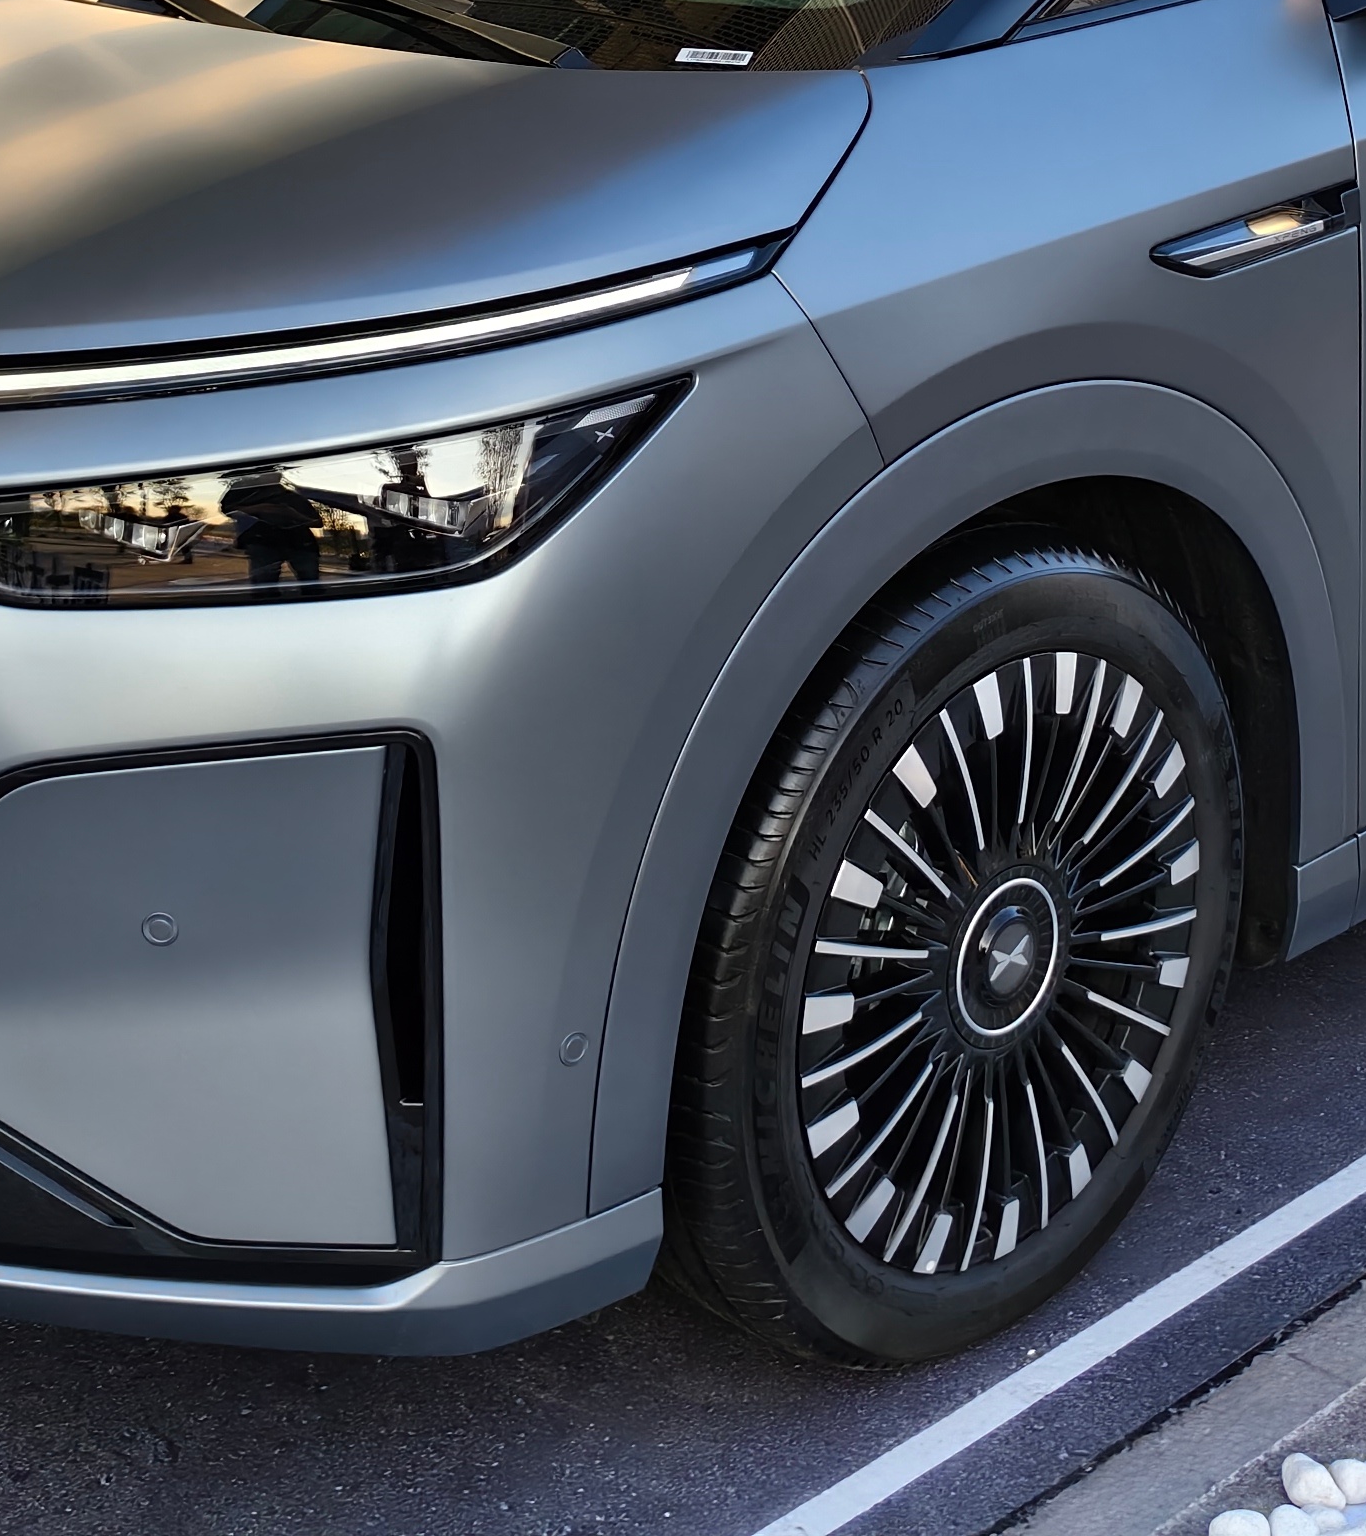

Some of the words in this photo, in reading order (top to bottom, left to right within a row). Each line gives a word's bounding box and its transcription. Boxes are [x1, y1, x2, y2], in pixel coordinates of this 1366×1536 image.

[1274, 226, 1317, 242] XPENG
[886, 698, 903, 727] 20
[755, 893, 803, 1175] MICHELIN
